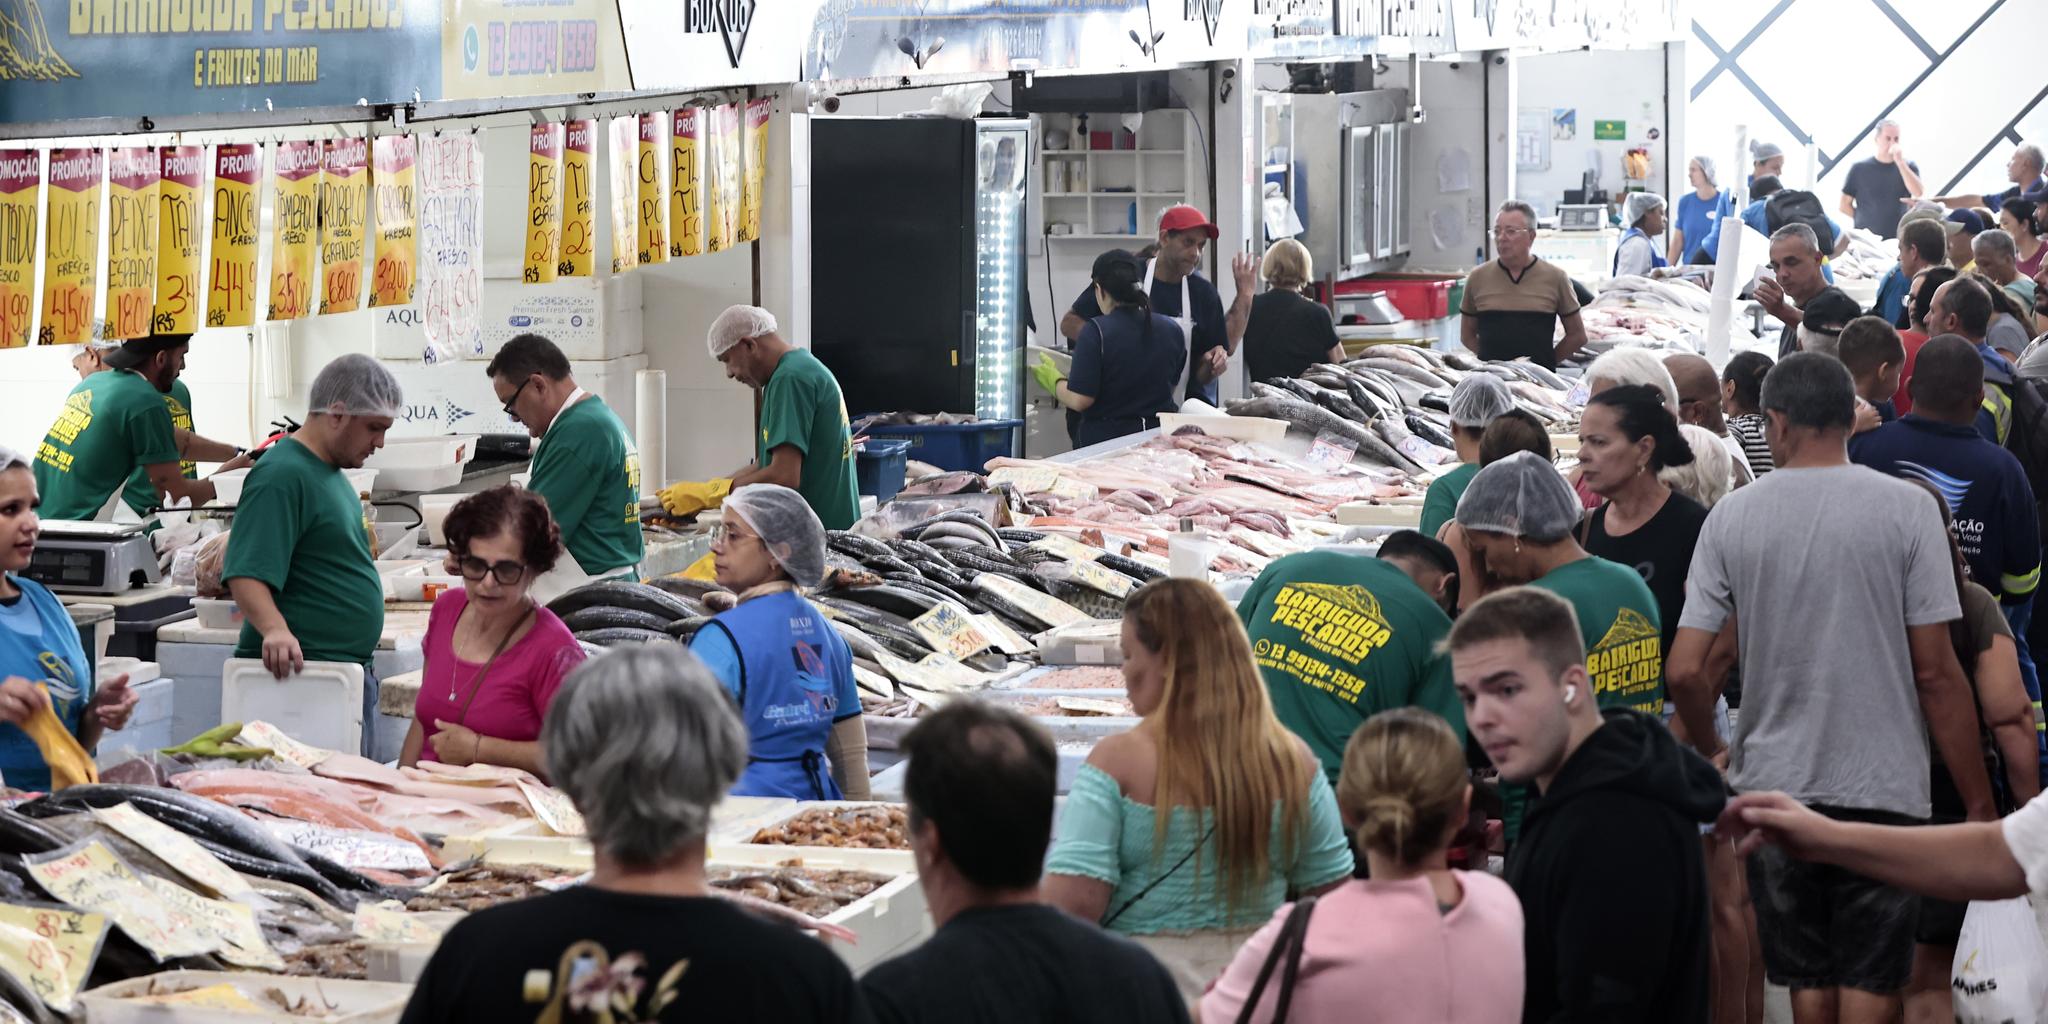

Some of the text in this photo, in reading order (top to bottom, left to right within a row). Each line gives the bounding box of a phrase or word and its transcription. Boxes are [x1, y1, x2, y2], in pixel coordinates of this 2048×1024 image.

[194, 47, 318, 87] E FRUTOS DO MAR
[488, 21, 505, 76] 13
[110, 193, 156, 256] PEIXE
[108, 257, 154, 290] ESPADA
[525, 264, 539, 282] R$
[1270, 606, 1374, 659] PESCADOS
[1274, 587, 1391, 648] BARRIGUDA
[1270, 643, 1366, 695] 13 99134-1358
